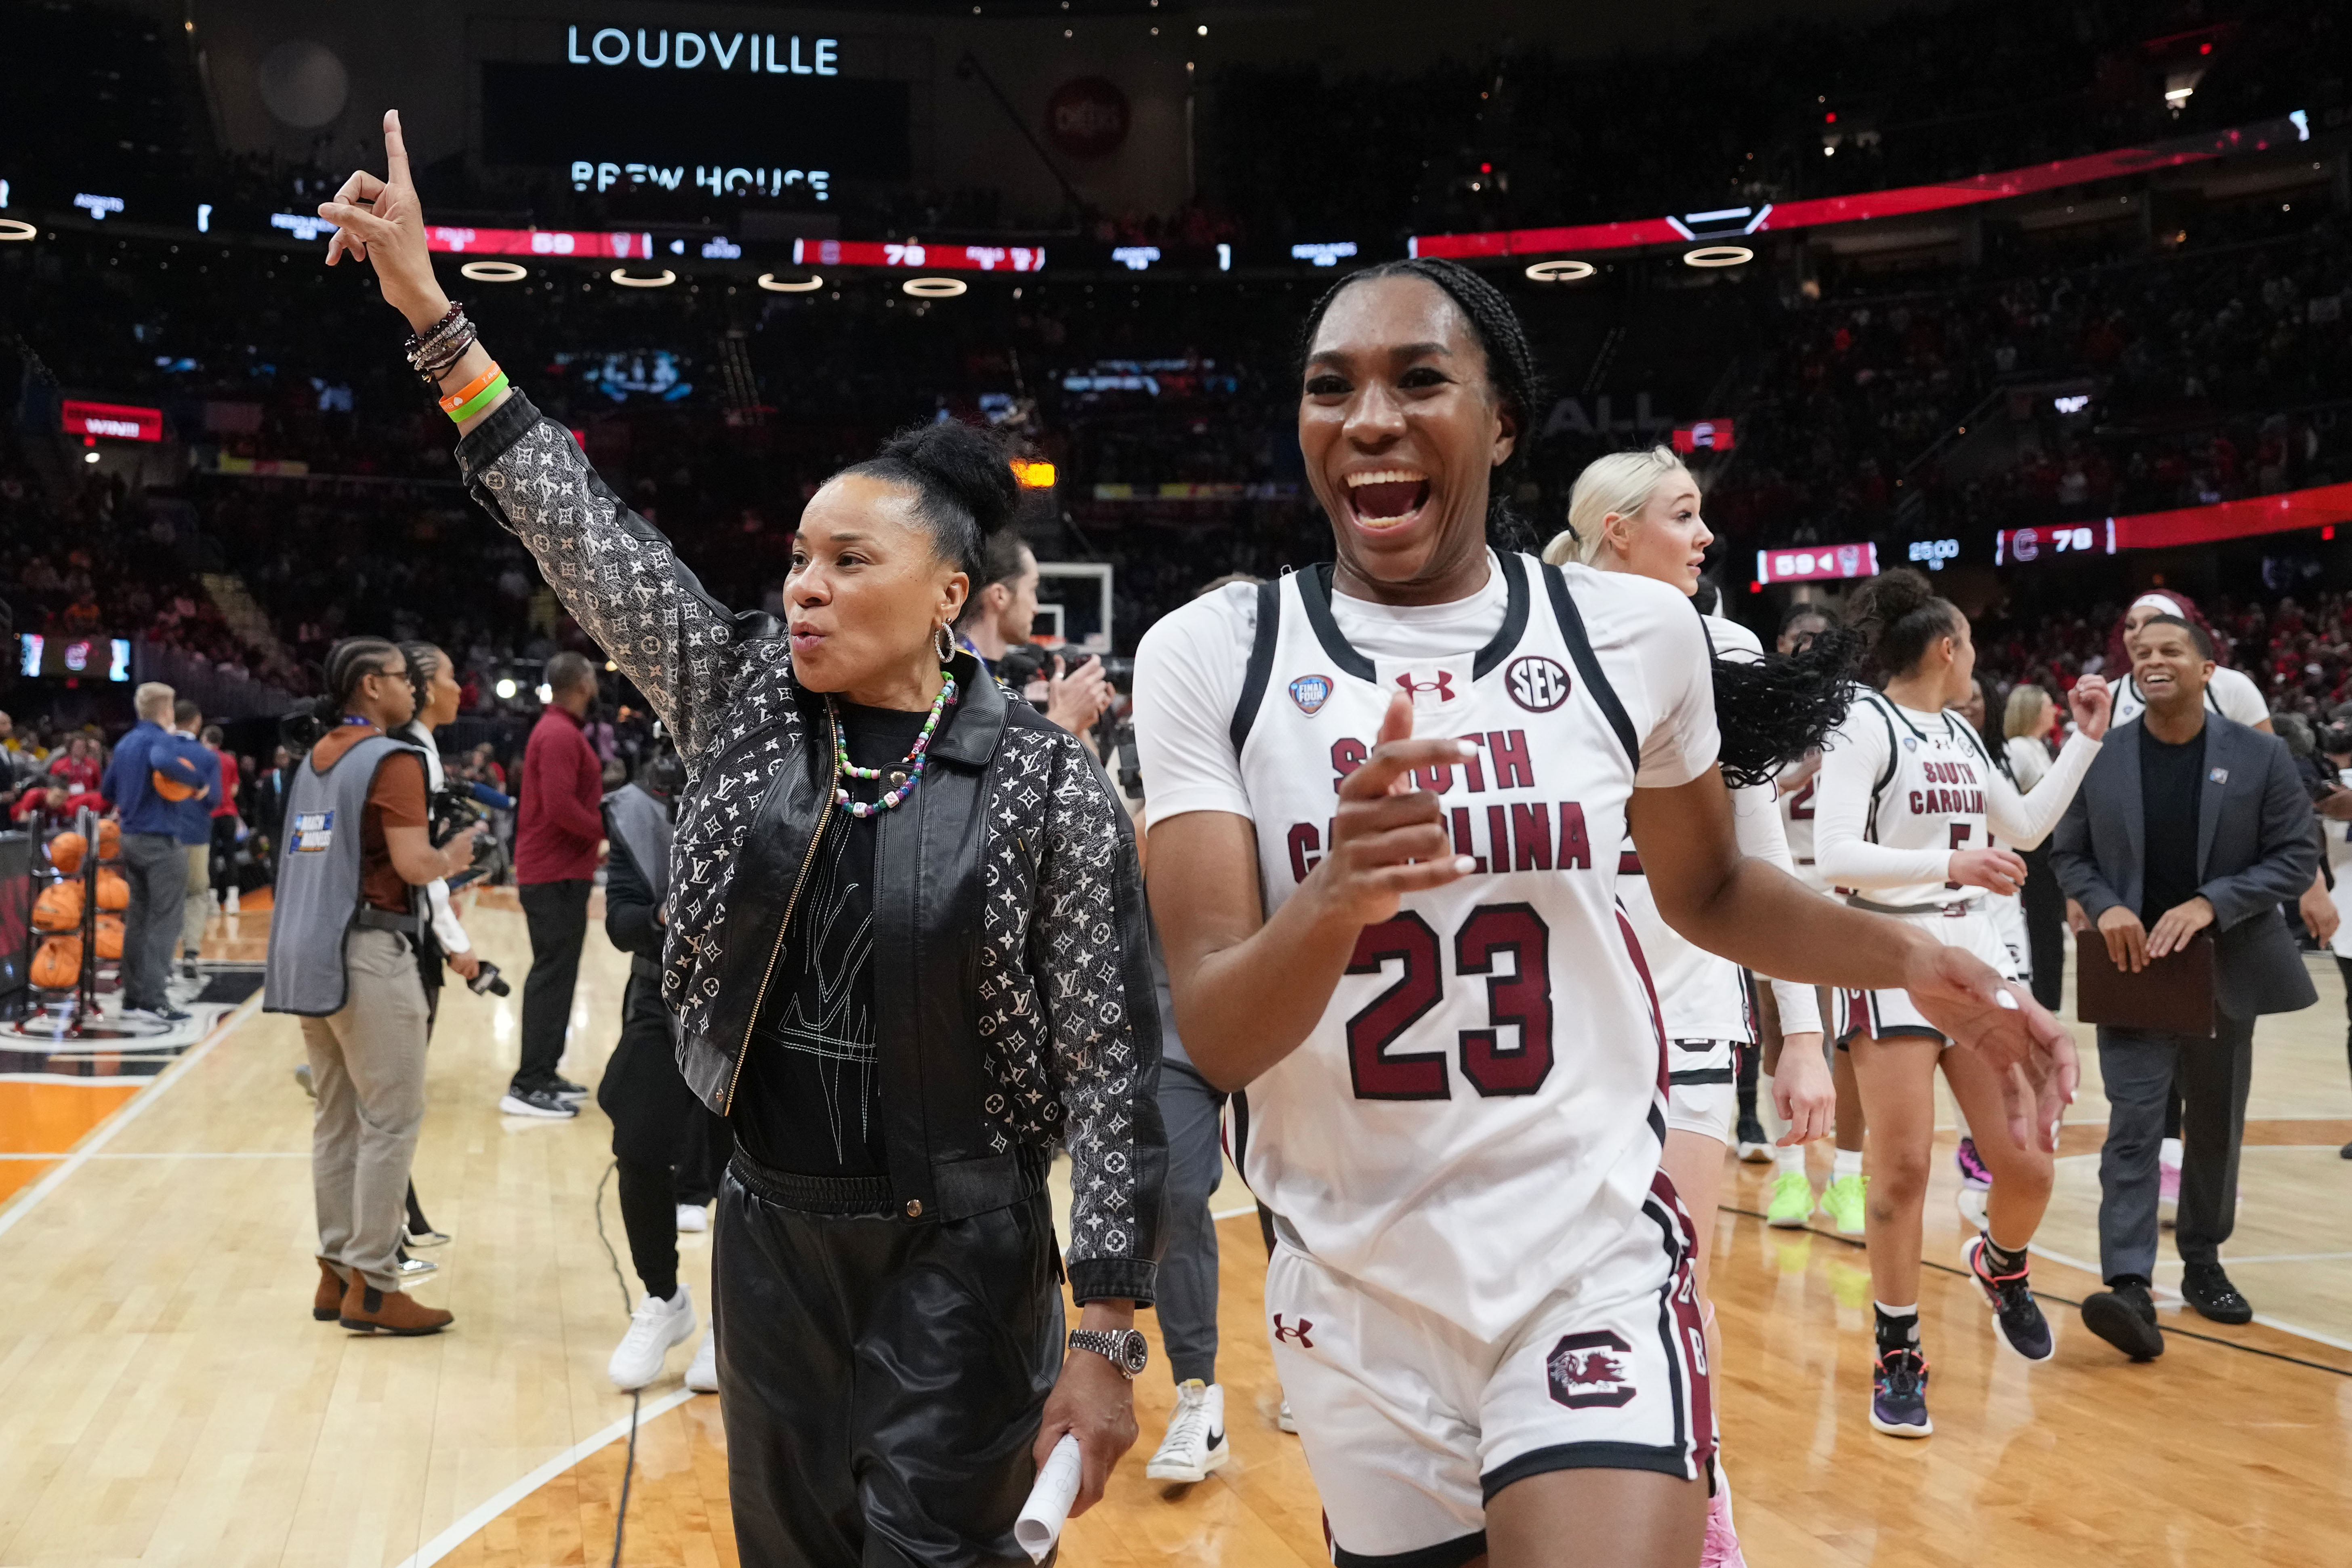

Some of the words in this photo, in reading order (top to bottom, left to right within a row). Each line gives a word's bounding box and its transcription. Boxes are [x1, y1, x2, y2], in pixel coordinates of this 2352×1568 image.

[568, 25, 838, 76] LOUDVILLE
[571, 161, 684, 193] BREW
[1298, 682, 1323, 693] FINAL
[1298, 691, 1324, 703] FOUR
[1510, 660, 1565, 708] SEC
[1330, 729, 1535, 796] SUTH
[1923, 761, 1978, 785] SOUTH
[1909, 788, 1987, 815] CAROLIN
[1287, 801, 1591, 885] CLINA
[1343, 901, 1555, 1101] 23
